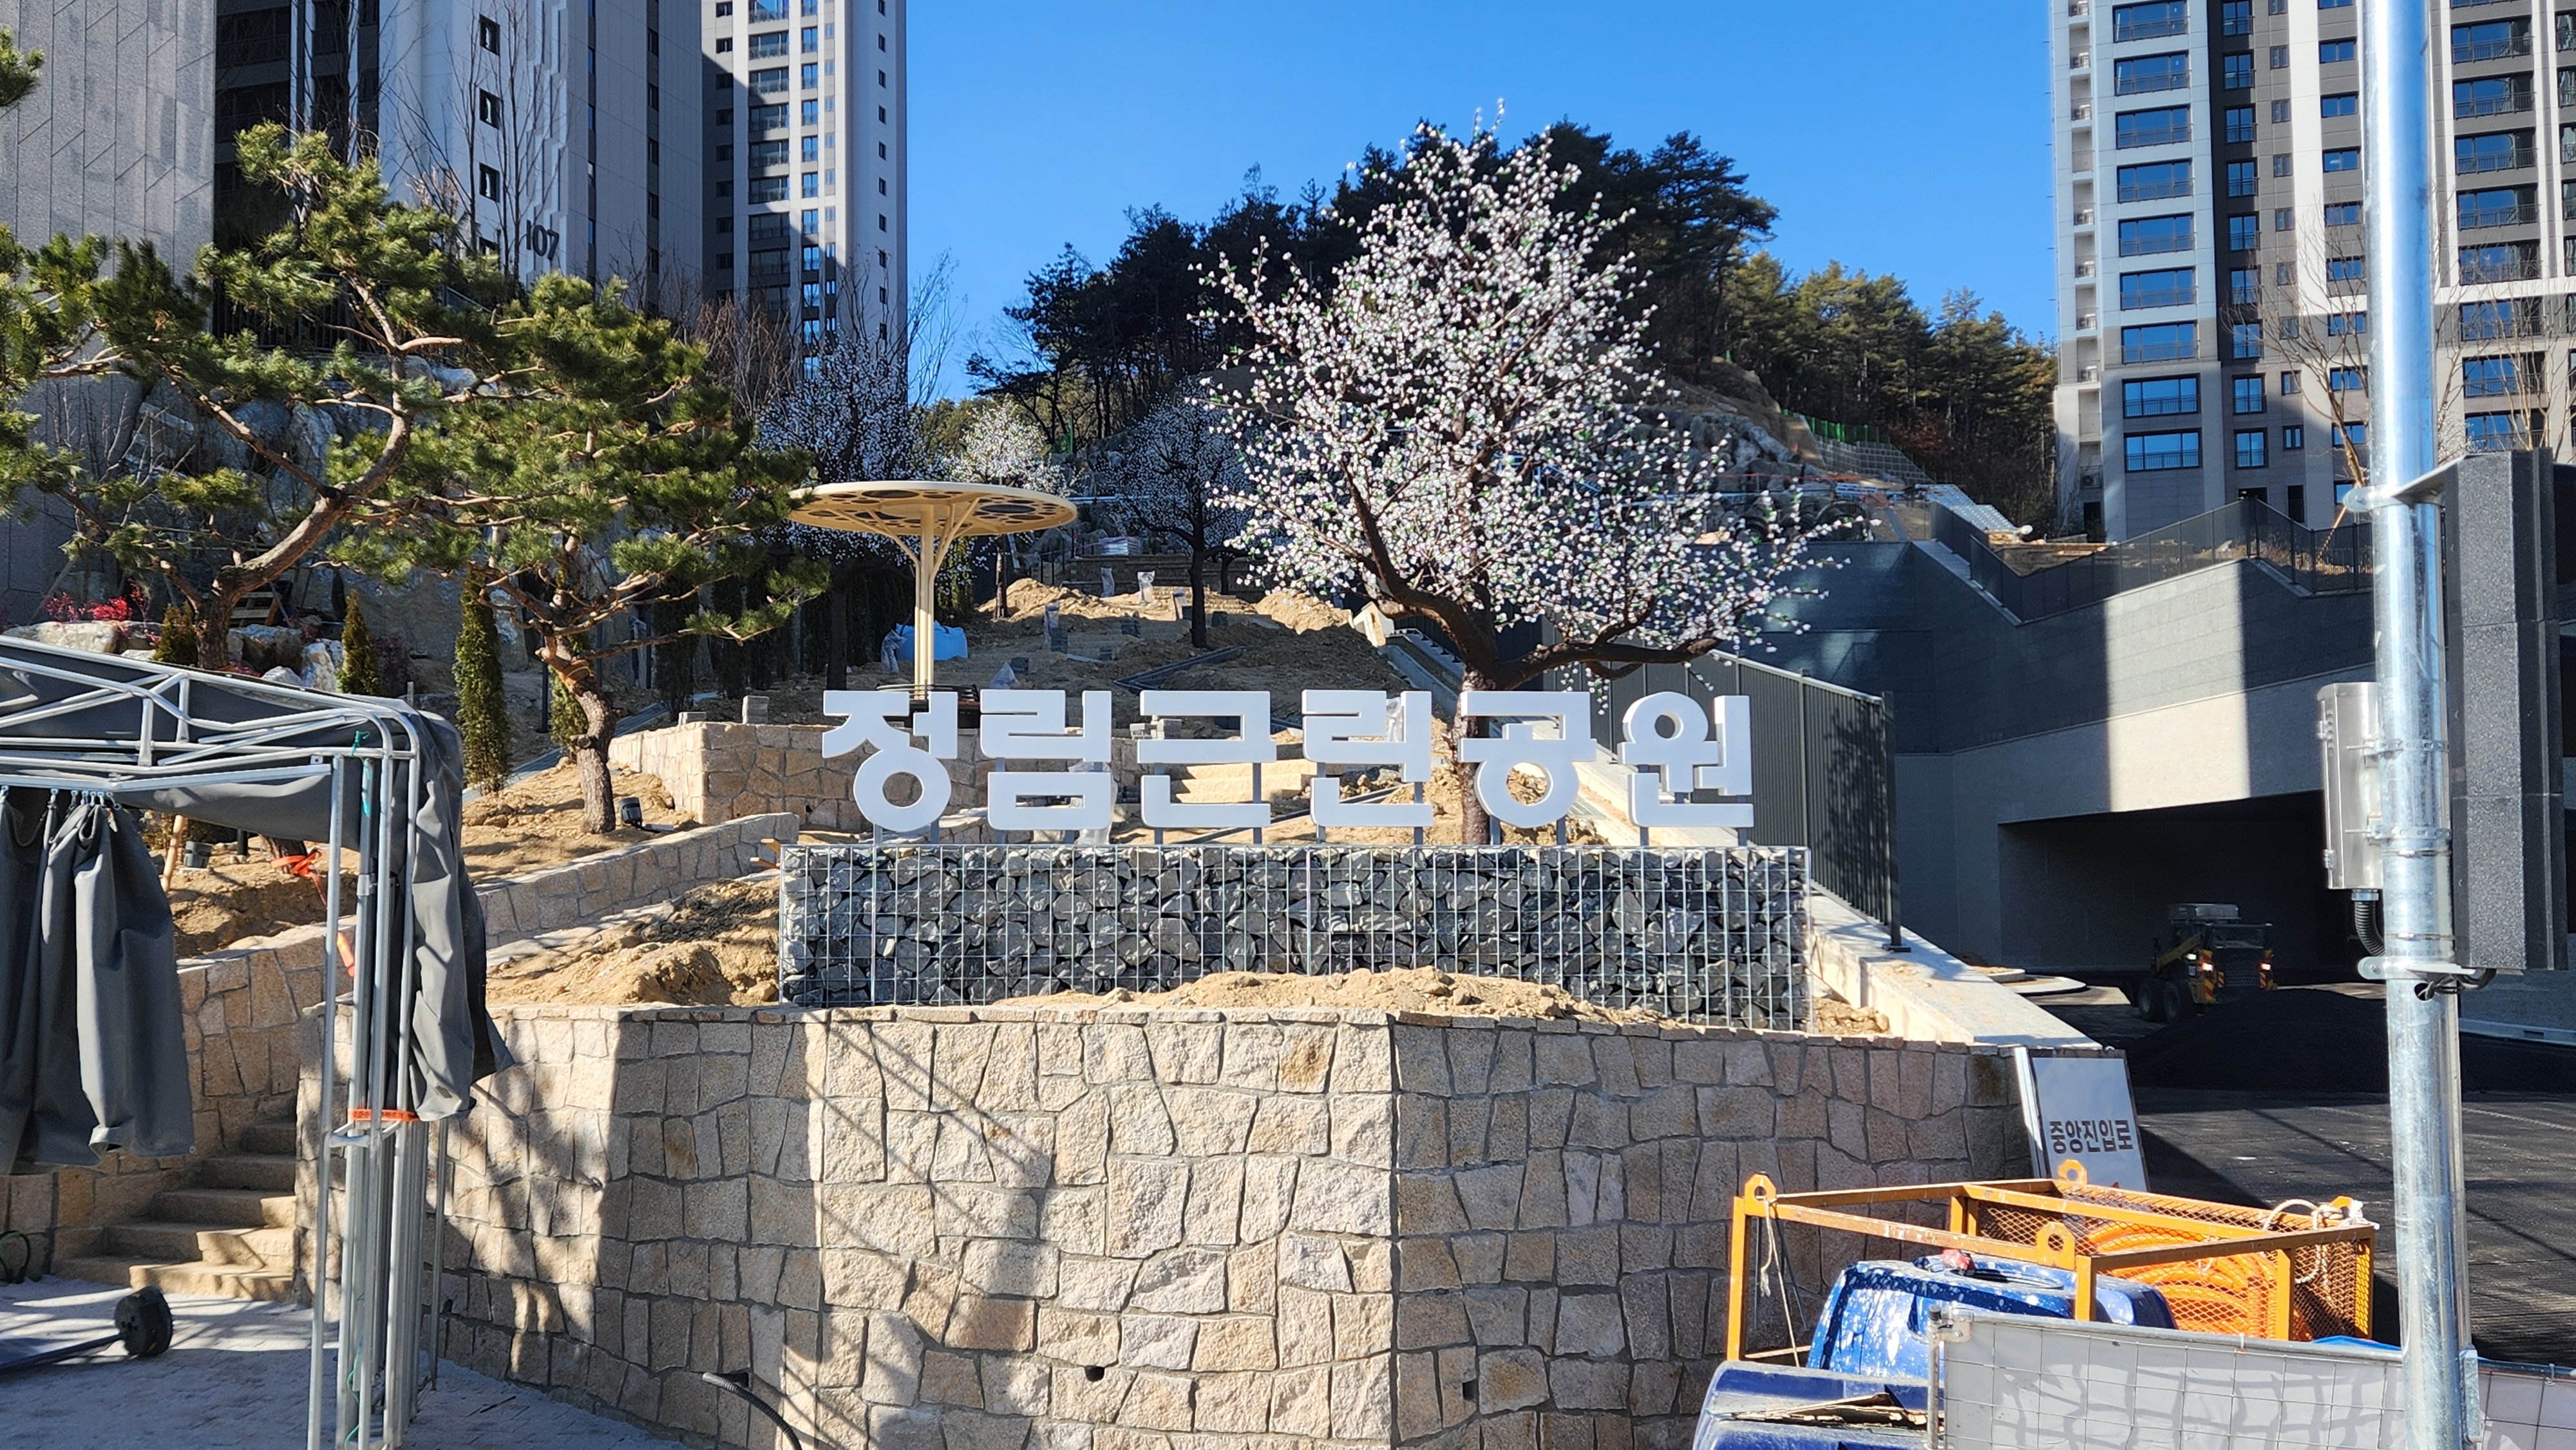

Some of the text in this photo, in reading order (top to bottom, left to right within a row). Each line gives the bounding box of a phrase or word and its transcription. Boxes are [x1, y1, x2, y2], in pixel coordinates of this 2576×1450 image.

[526, 220, 560, 261] 107
[822, 689, 1754, 833] 정림근린공원
[2049, 1120, 2134, 1154] 중앙진입로
